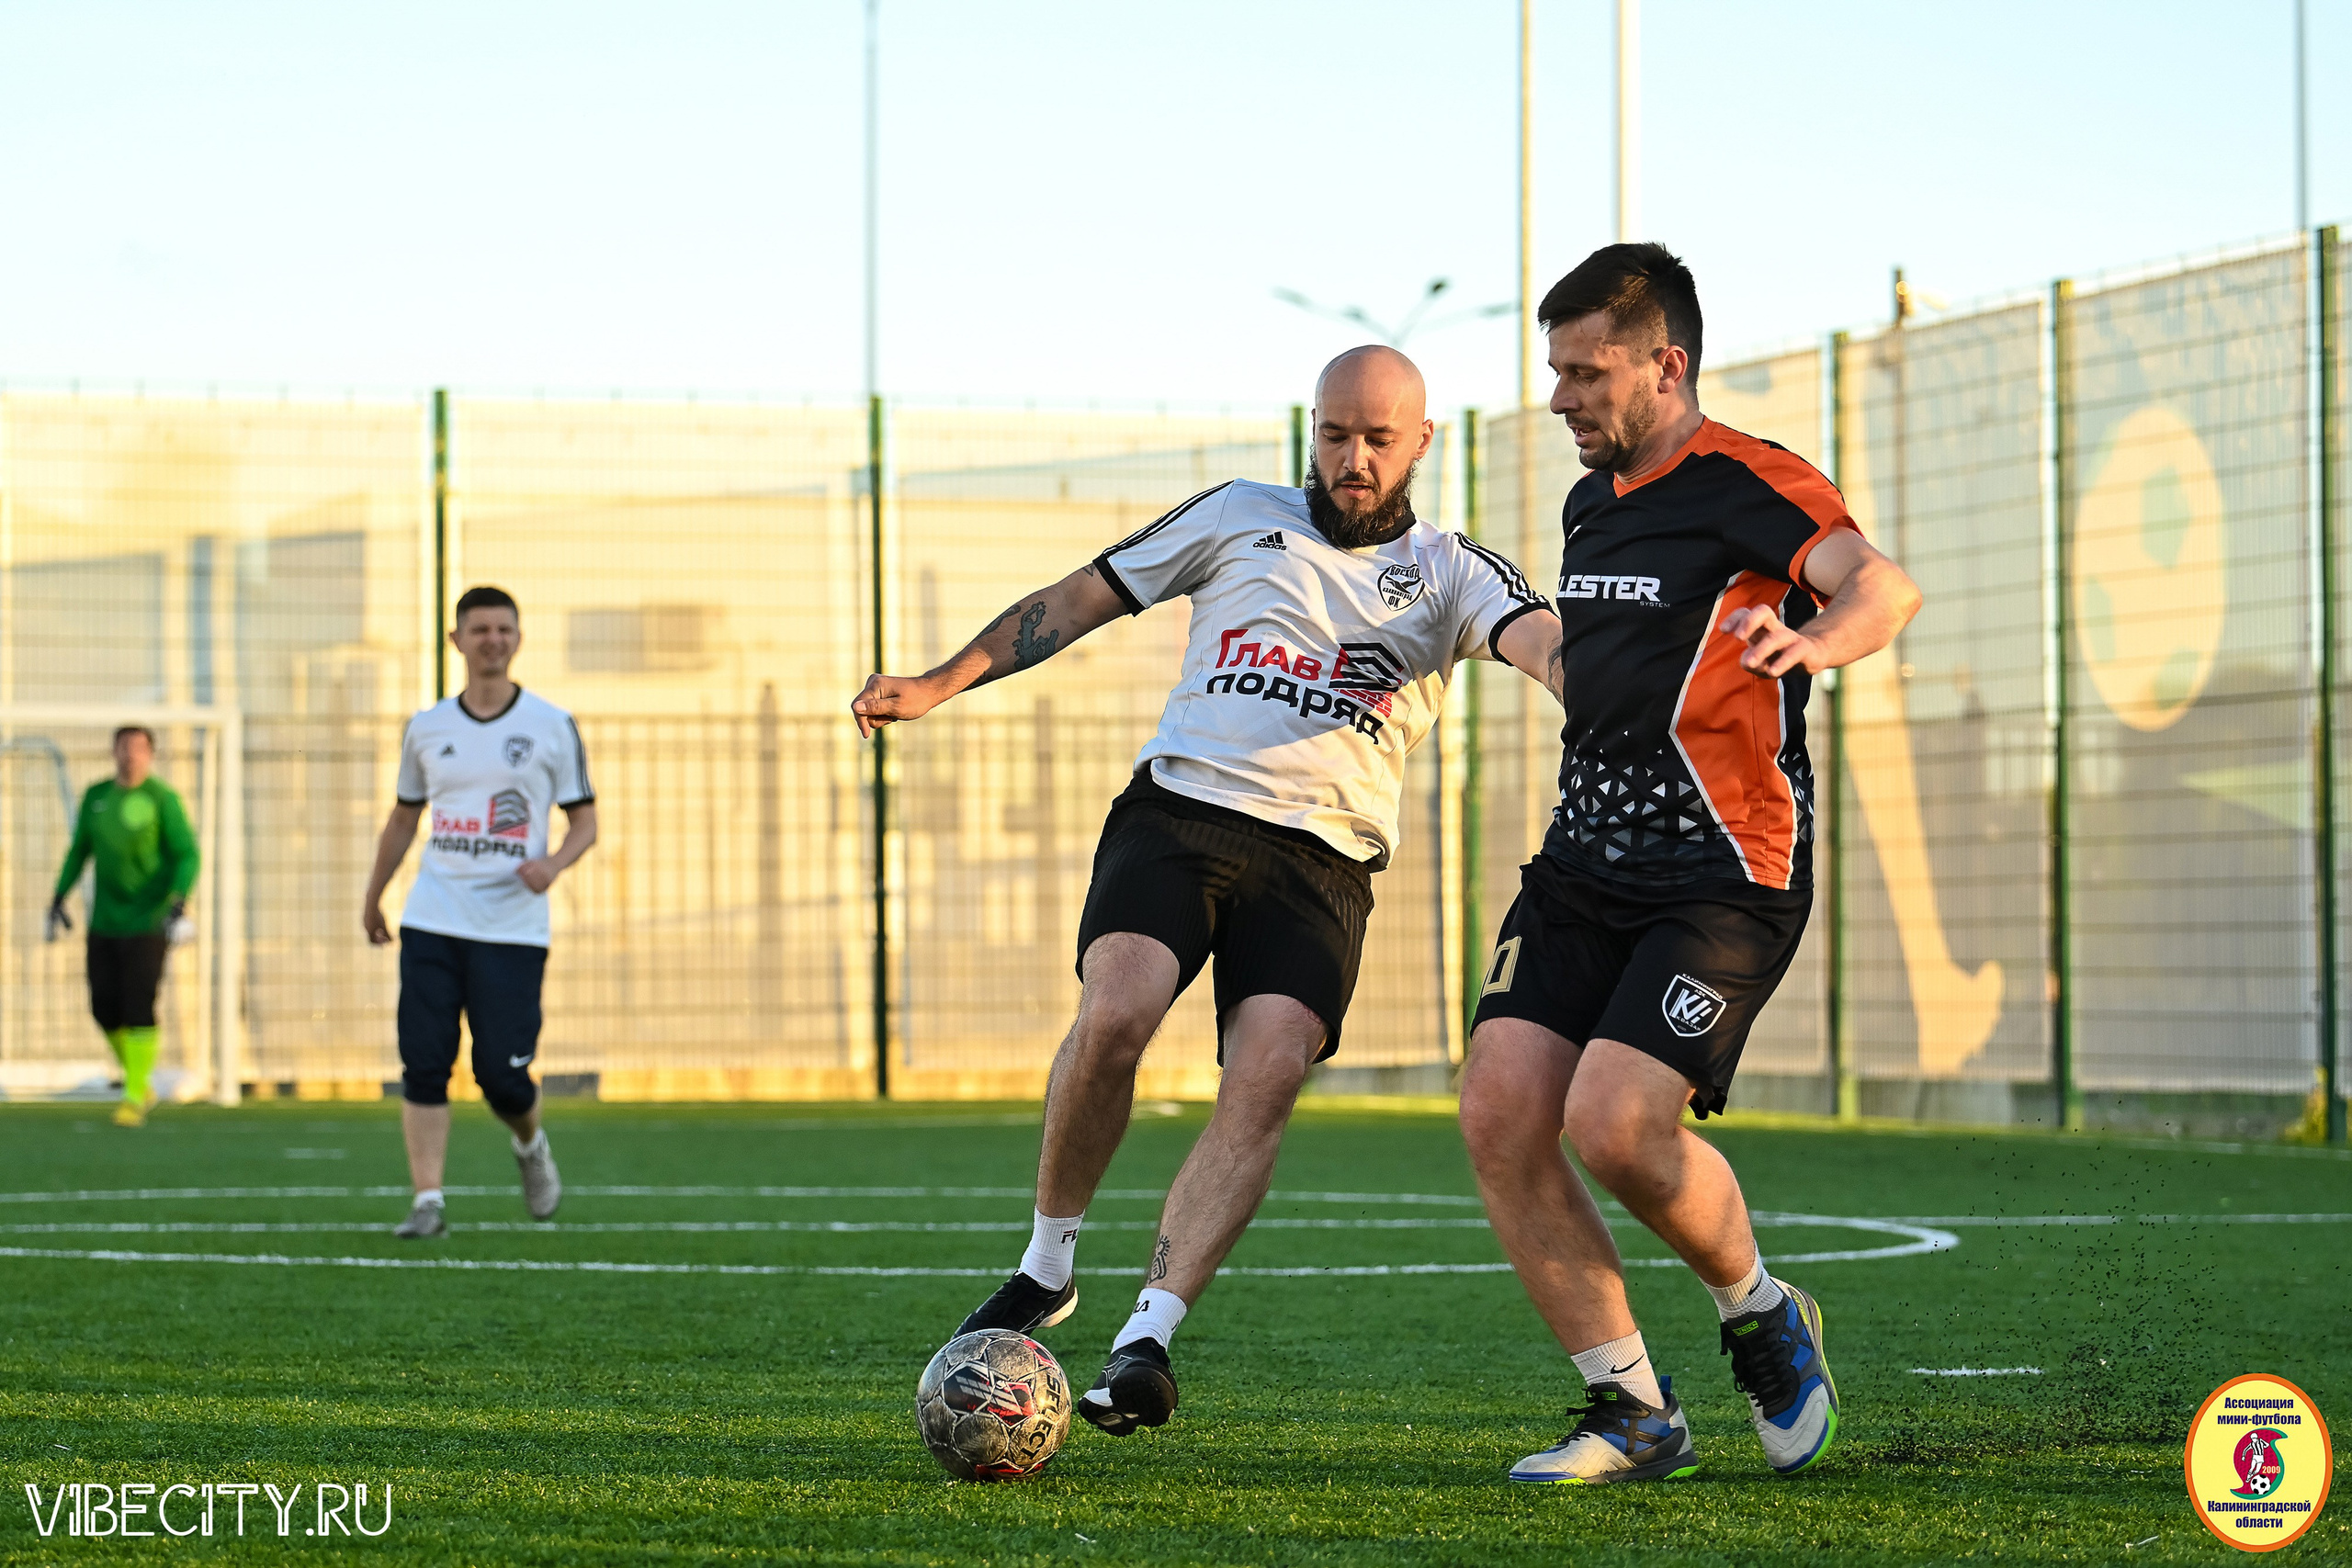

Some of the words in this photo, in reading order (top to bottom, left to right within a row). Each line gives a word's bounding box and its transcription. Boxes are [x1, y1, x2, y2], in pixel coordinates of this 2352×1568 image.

[1252, 540, 1287, 551] adidas
[1639, 600, 1670, 608] SYSTEM
[1020, 1373, 1061, 1461] SELECT
